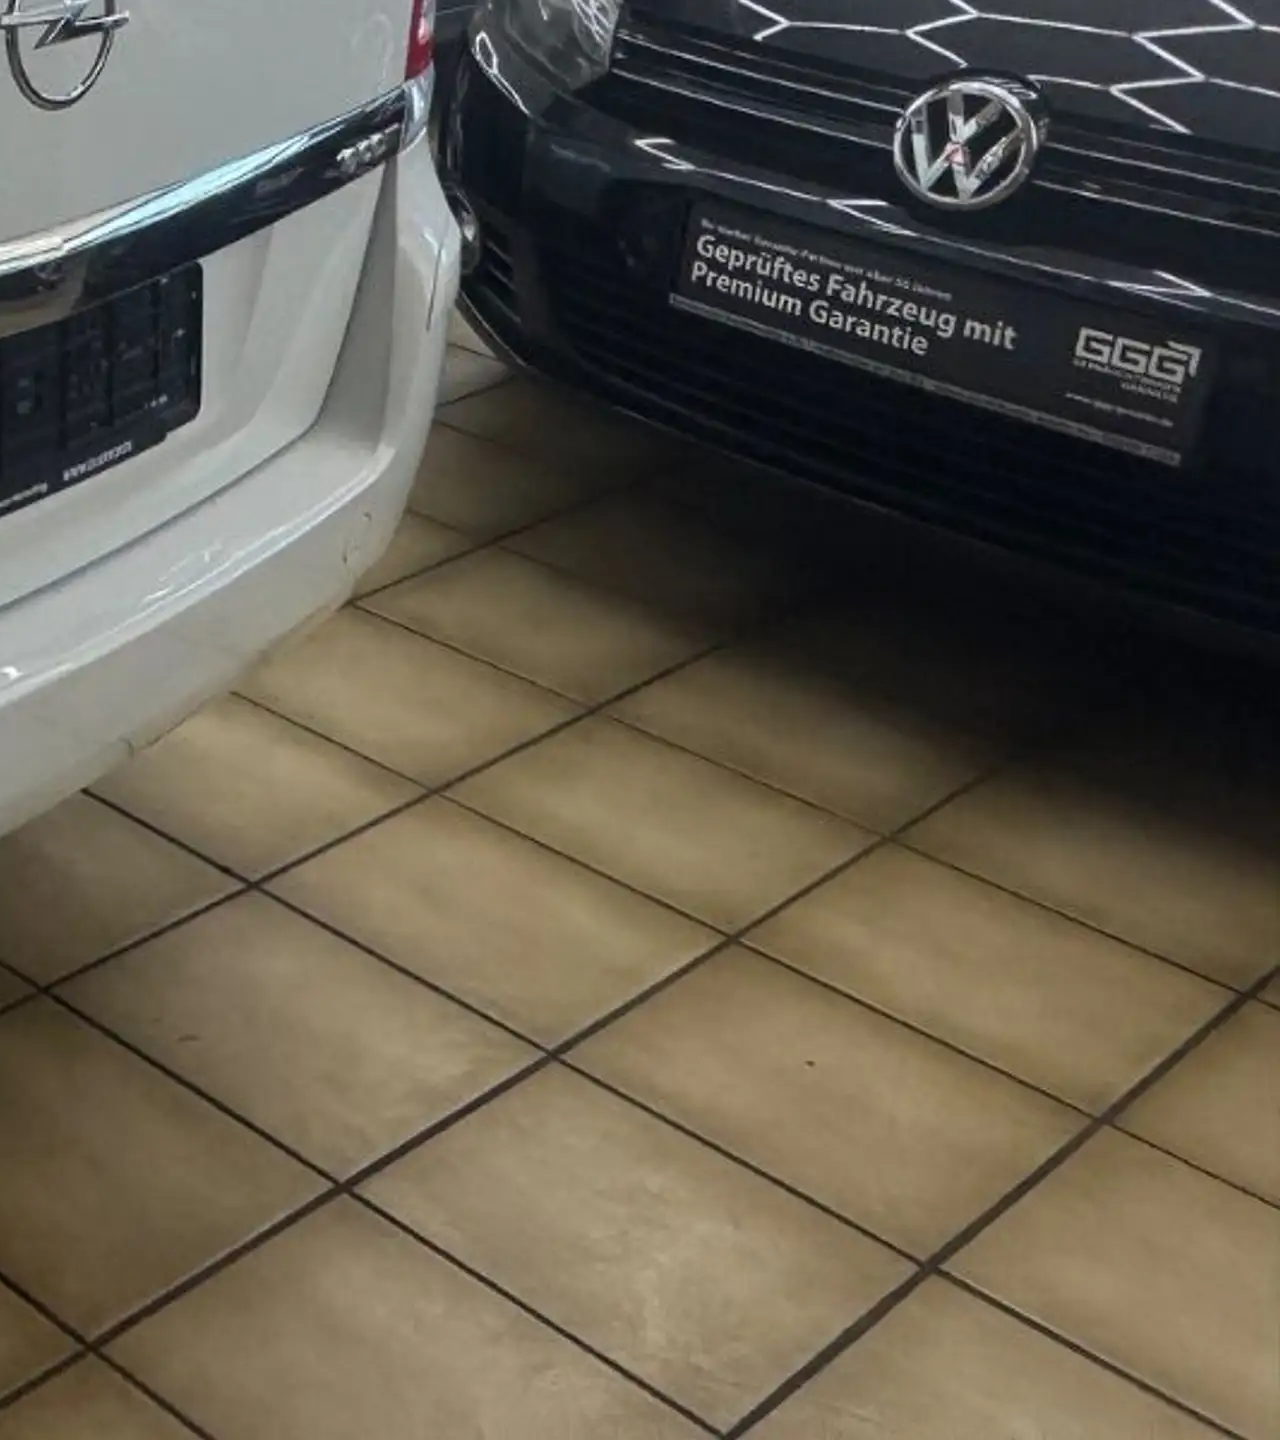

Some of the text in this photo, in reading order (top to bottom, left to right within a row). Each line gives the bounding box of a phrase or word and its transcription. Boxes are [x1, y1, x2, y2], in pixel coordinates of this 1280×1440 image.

[691, 262, 930, 356] Premium Garantie
[696, 234, 821, 292] Geprüftes
[826, 273, 958, 338] Fahrzeug
[962, 317, 1018, 350] mit
